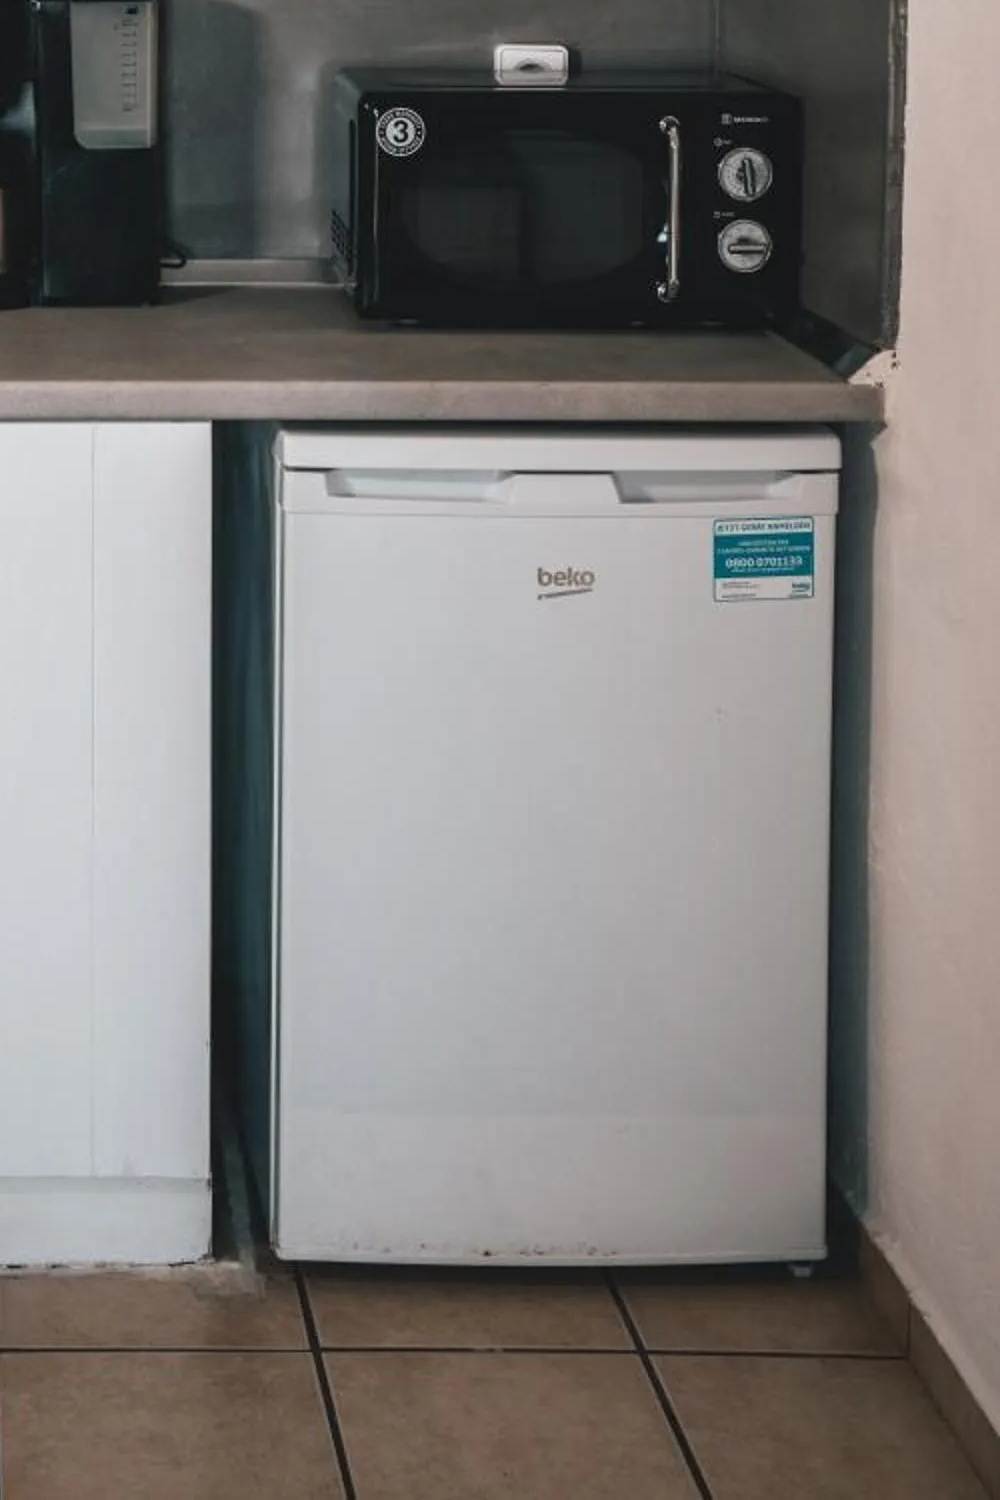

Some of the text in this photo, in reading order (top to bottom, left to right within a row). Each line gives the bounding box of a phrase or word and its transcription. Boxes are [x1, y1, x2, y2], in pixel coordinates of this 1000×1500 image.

[393, 120, 408, 142] 3
[725, 557, 753, 568] 0800
[537, 566, 596, 586] beko
